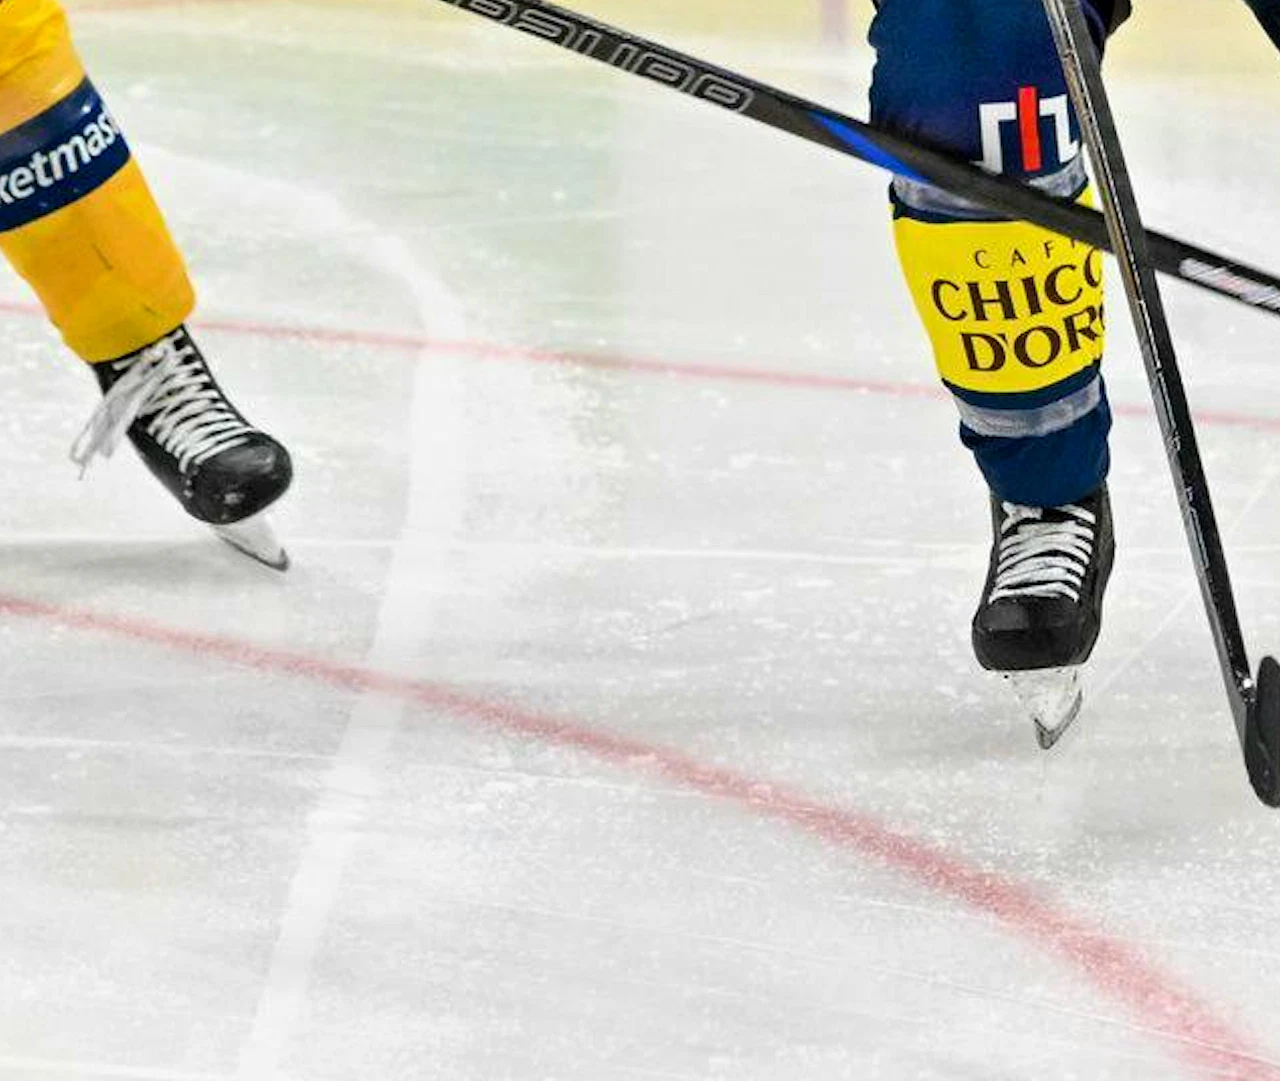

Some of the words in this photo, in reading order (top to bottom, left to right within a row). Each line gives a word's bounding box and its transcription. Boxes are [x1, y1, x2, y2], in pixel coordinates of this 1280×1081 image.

[931, 246, 1102, 322] CHICC
[974, 238, 1076, 269] CAF
[959, 304, 1105, 372] D'OR
